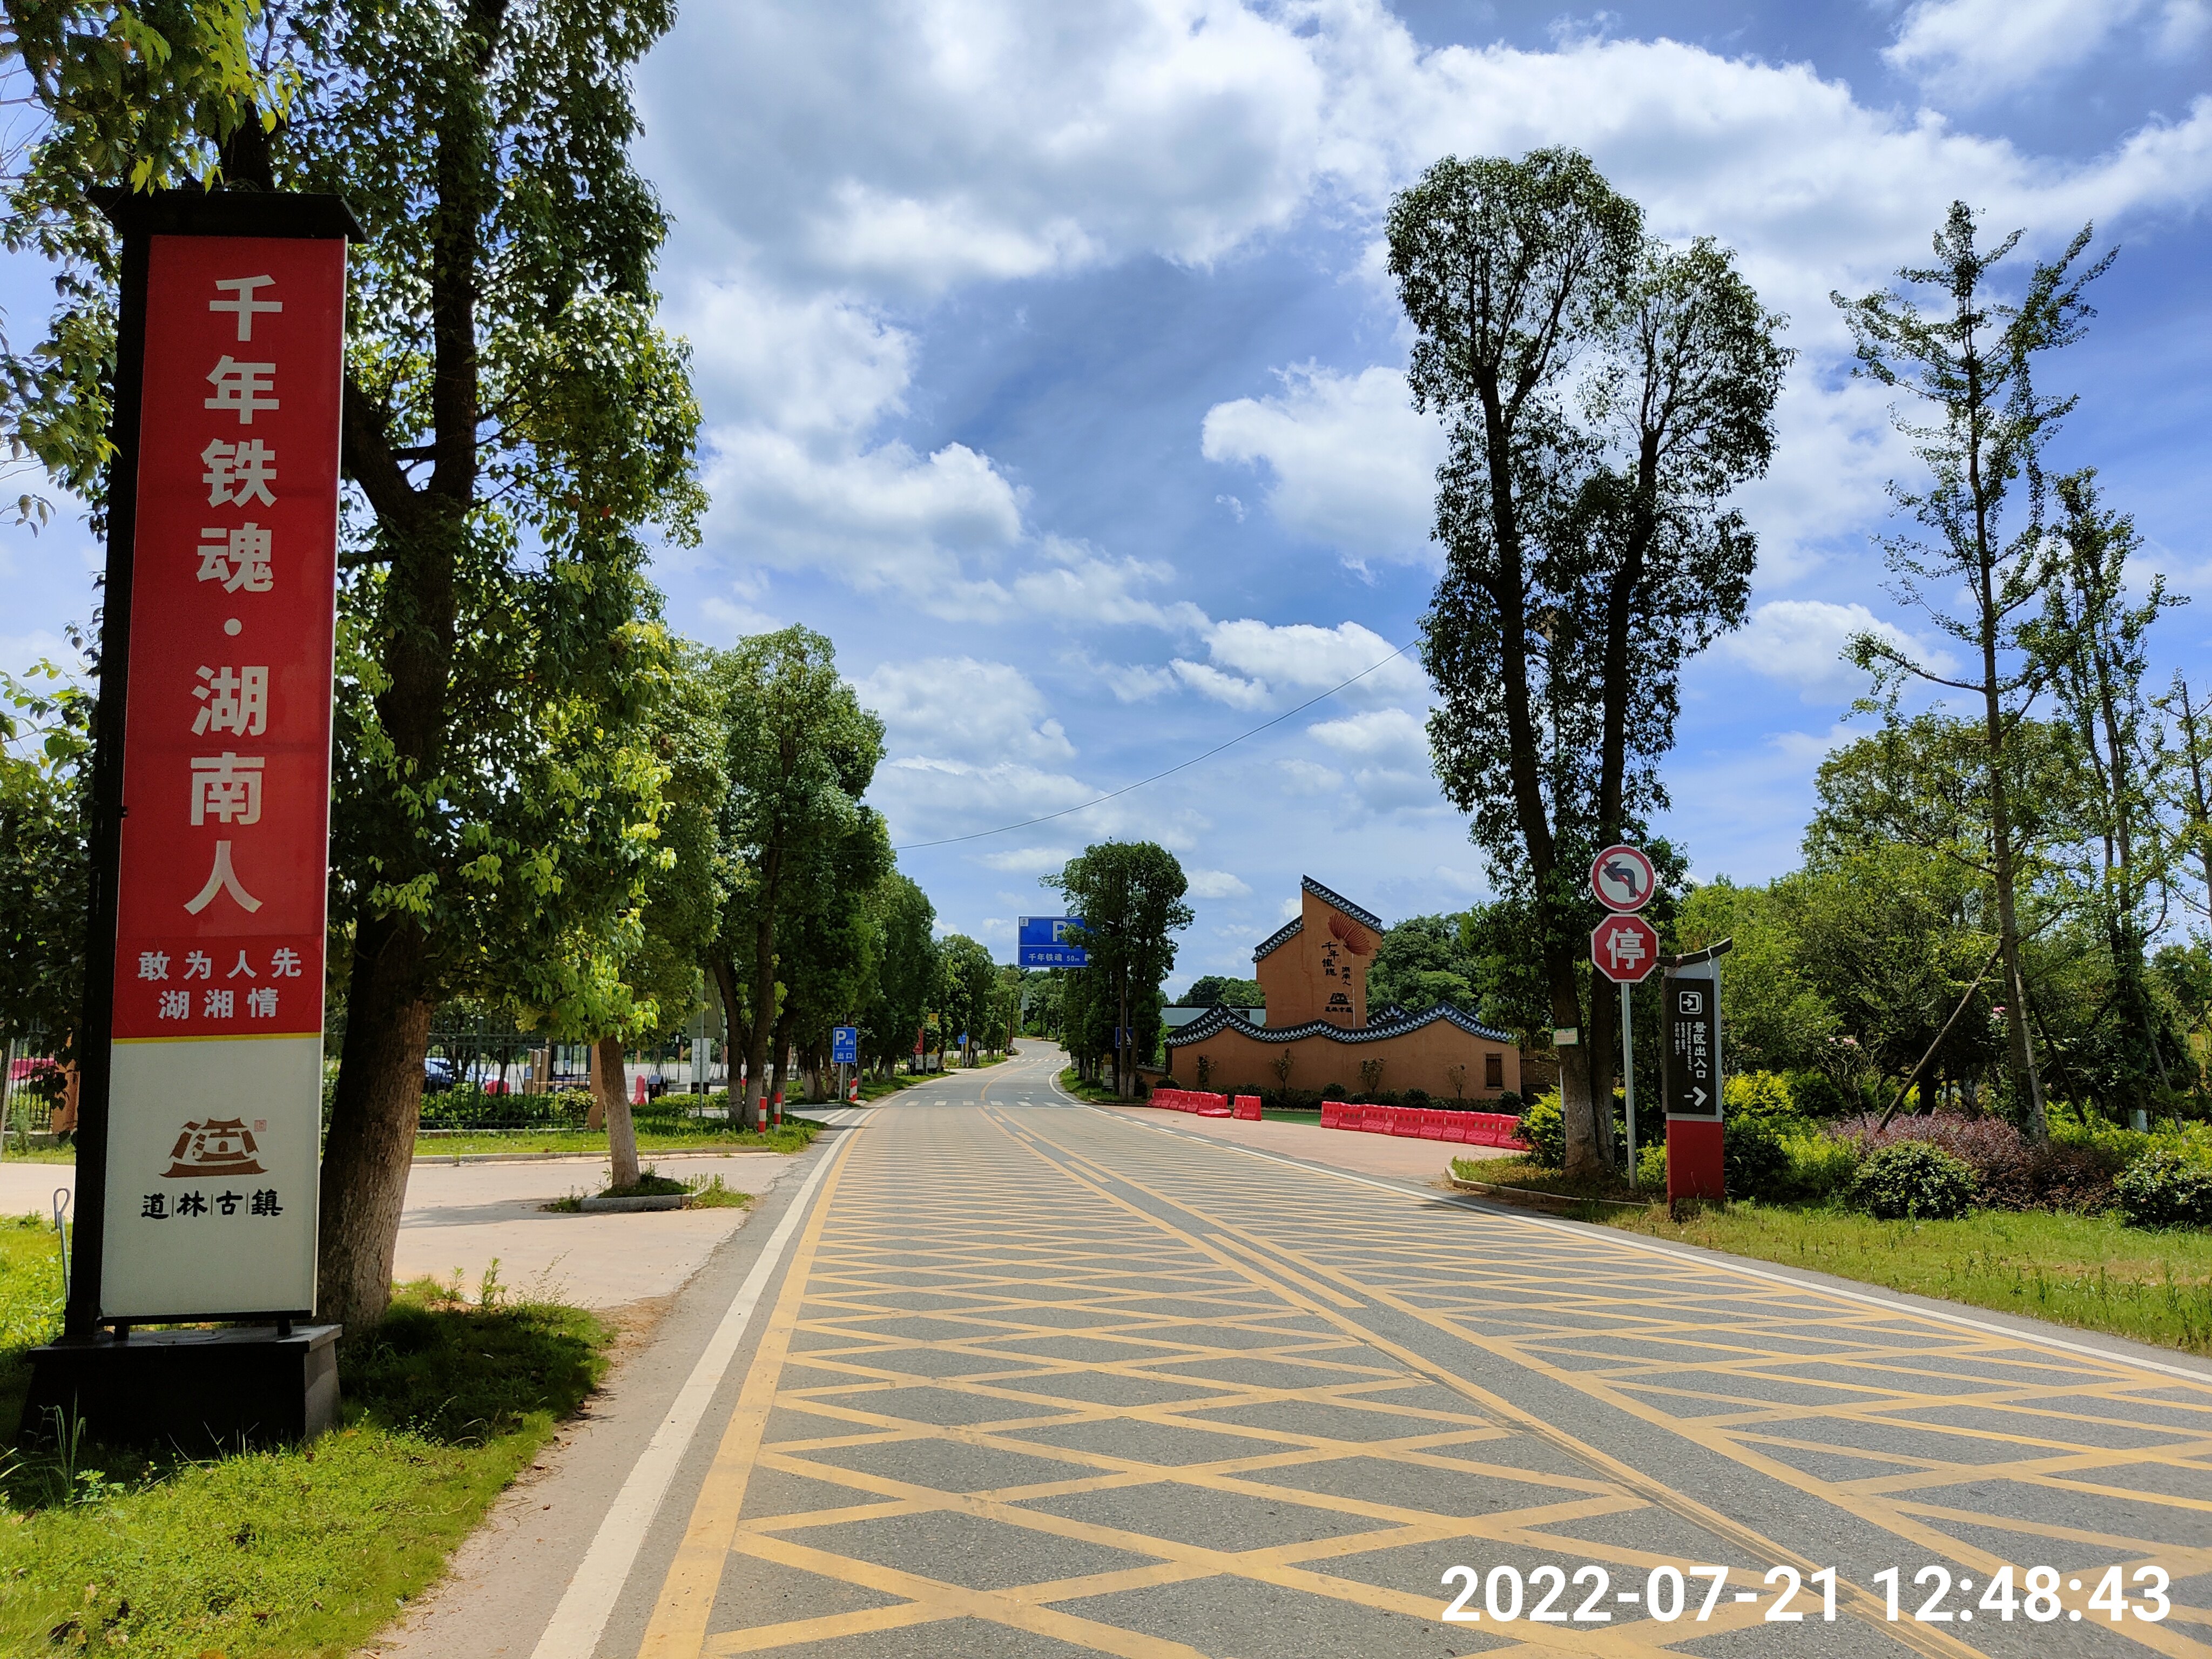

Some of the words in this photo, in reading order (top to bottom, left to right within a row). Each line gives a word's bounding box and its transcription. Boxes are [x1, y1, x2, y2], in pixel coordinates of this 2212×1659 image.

[1053, 921, 1068, 942] P
[1028, 953, 1062, 962] 千年铁魂
[1606, 927, 1645, 970] 停
[138, 947, 302, 981] 敢为人先
[158, 987, 279, 1020] 湖湘情
[835, 1030, 847, 1046] P
[1693, 1021, 1708, 1078] 景区出入口
[837, 1051, 853, 1060] 出口
